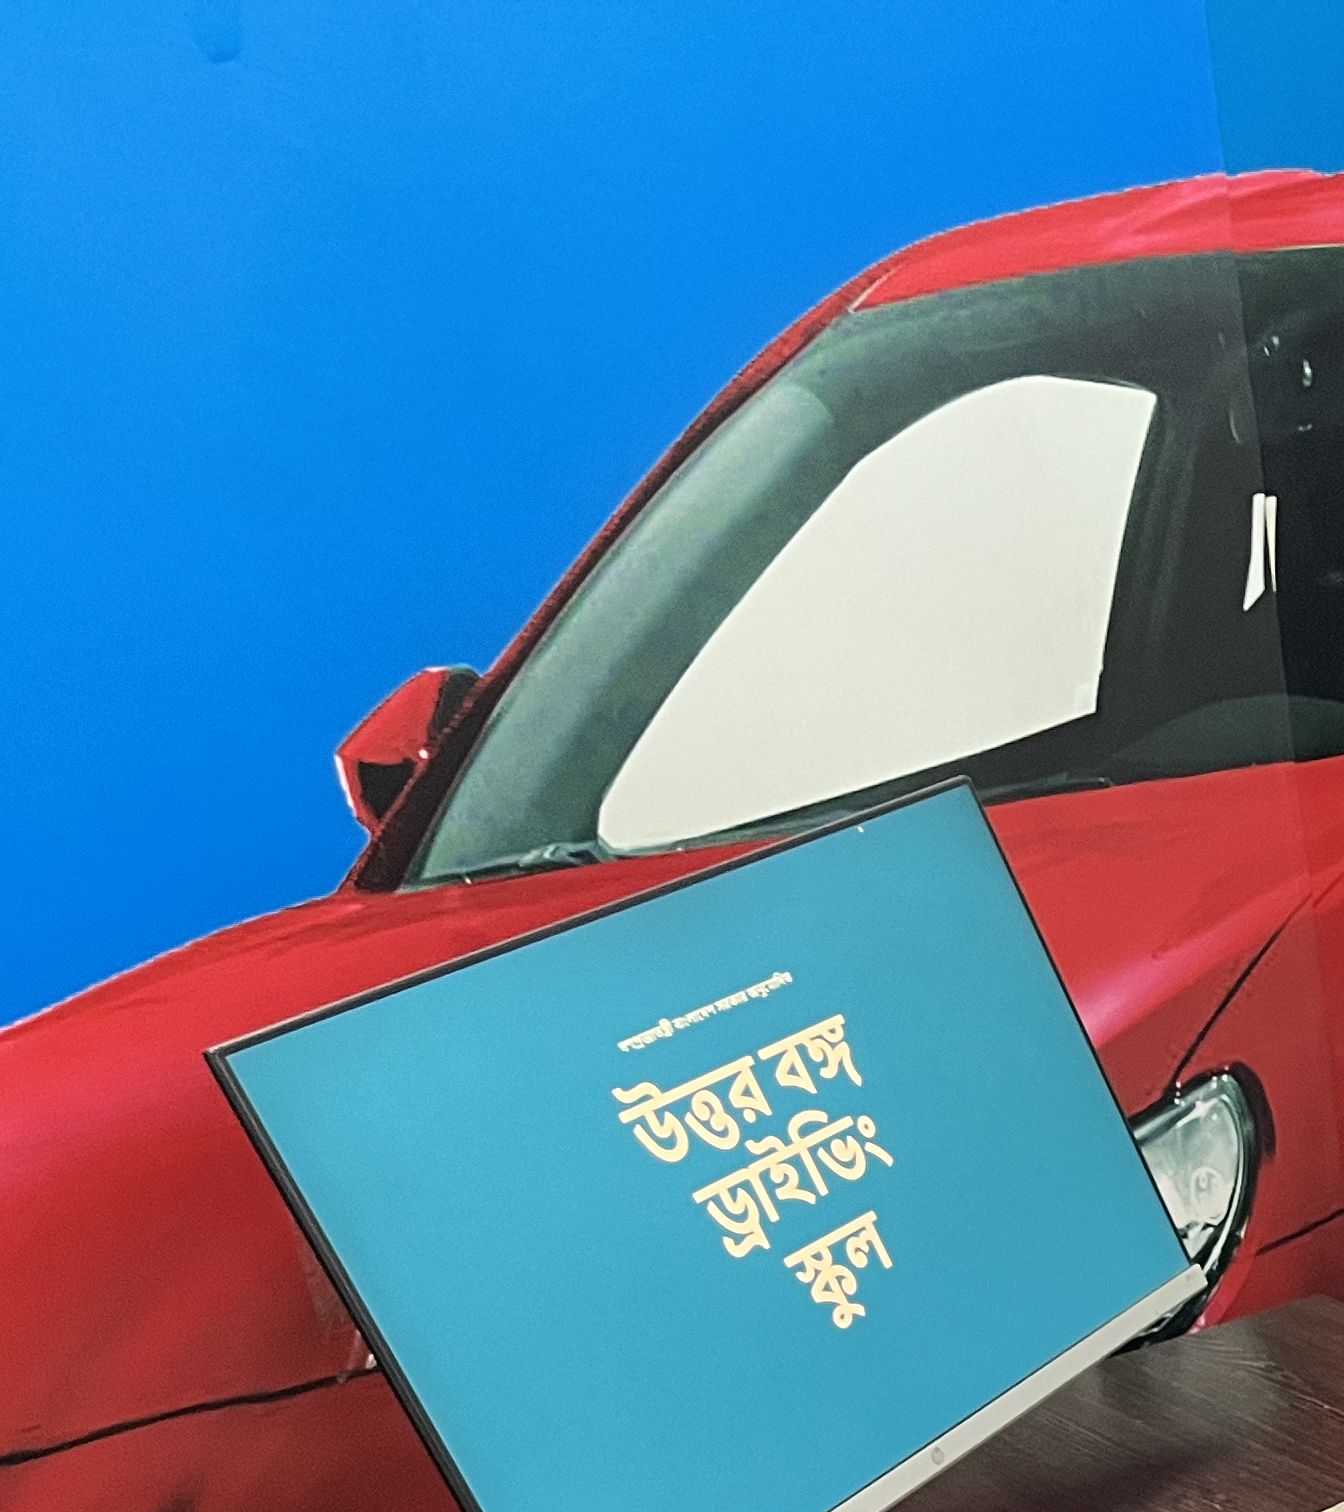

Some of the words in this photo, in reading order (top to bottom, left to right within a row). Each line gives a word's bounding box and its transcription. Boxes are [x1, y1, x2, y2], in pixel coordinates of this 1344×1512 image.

[612, 1055, 772, 1162] উত্তর
[758, 1013, 862, 1094] বঙ্গ
[692, 1109, 893, 1258] ড্রাইভিং
[784, 1210, 892, 1329] স্কুল
